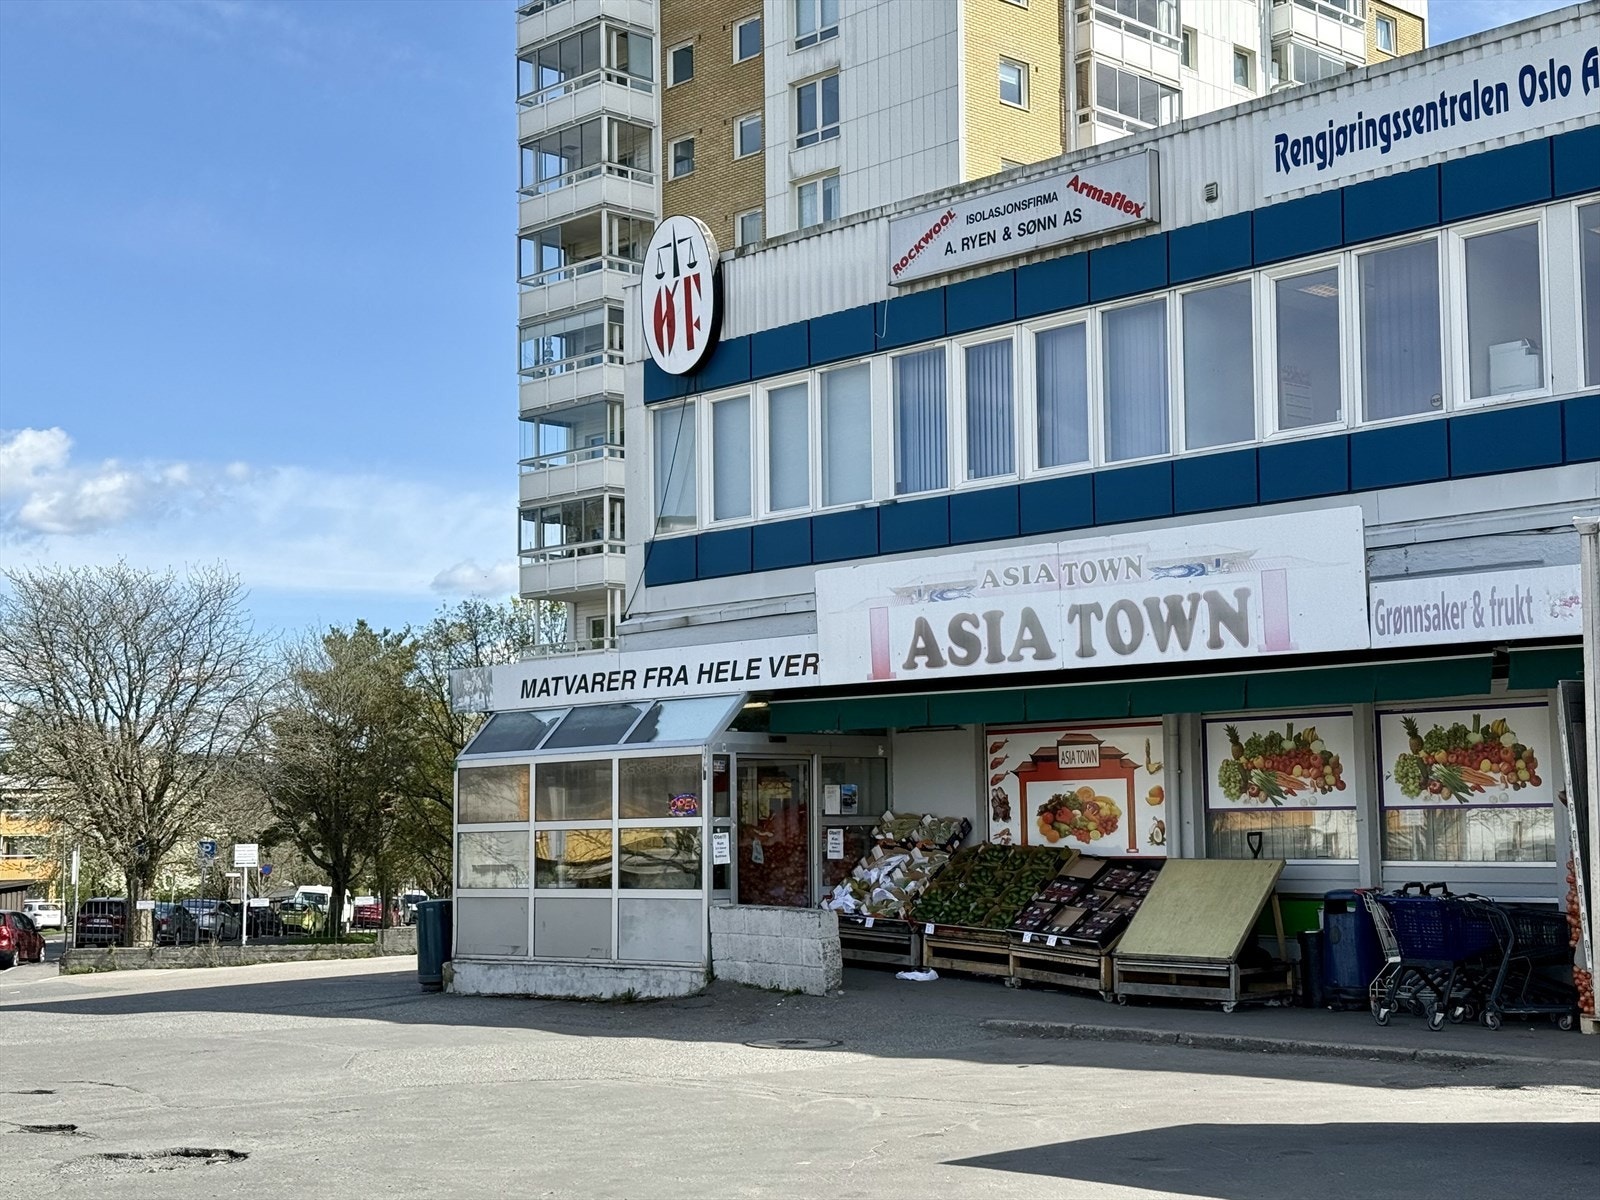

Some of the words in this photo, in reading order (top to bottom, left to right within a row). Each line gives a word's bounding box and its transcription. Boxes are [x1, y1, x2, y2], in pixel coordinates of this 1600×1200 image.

[1274, 79, 1509, 175] Rengjøringssentralen
[1518, 58, 1572, 107] Oslo
[966, 191, 1059, 225] ISOLASJONSFIRMA
[1067, 175, 1144, 218] Armaflex
[892, 210, 956, 275] ROCKWOOL
[944, 241, 957, 256] A.
[961, 230, 997, 252] RYEN
[1002, 226, 1012, 241] &
[1017, 213, 1057, 236] SØNN
[1063, 208, 1083, 226] AS
[979, 563, 1056, 589] ASIA
[1061, 555, 1143, 585] TOWN
[902, 605, 1057, 670] ASIA
[1067, 587, 1252, 659] TOWN
[1374, 591, 1467, 636] Grønnsaker
[1472, 590, 1485, 628] &
[1489, 584, 1534, 627] frukt
[520, 669, 637, 699] MATVARER
[643, 665, 689, 689] FRA
[696, 657, 762, 684] HELE
[768, 652, 820, 678] VER
[1061, 750, 1076, 765] ASIA
[1076, 749, 1098, 764] TOWN
[671, 798, 698, 810] OPEN
